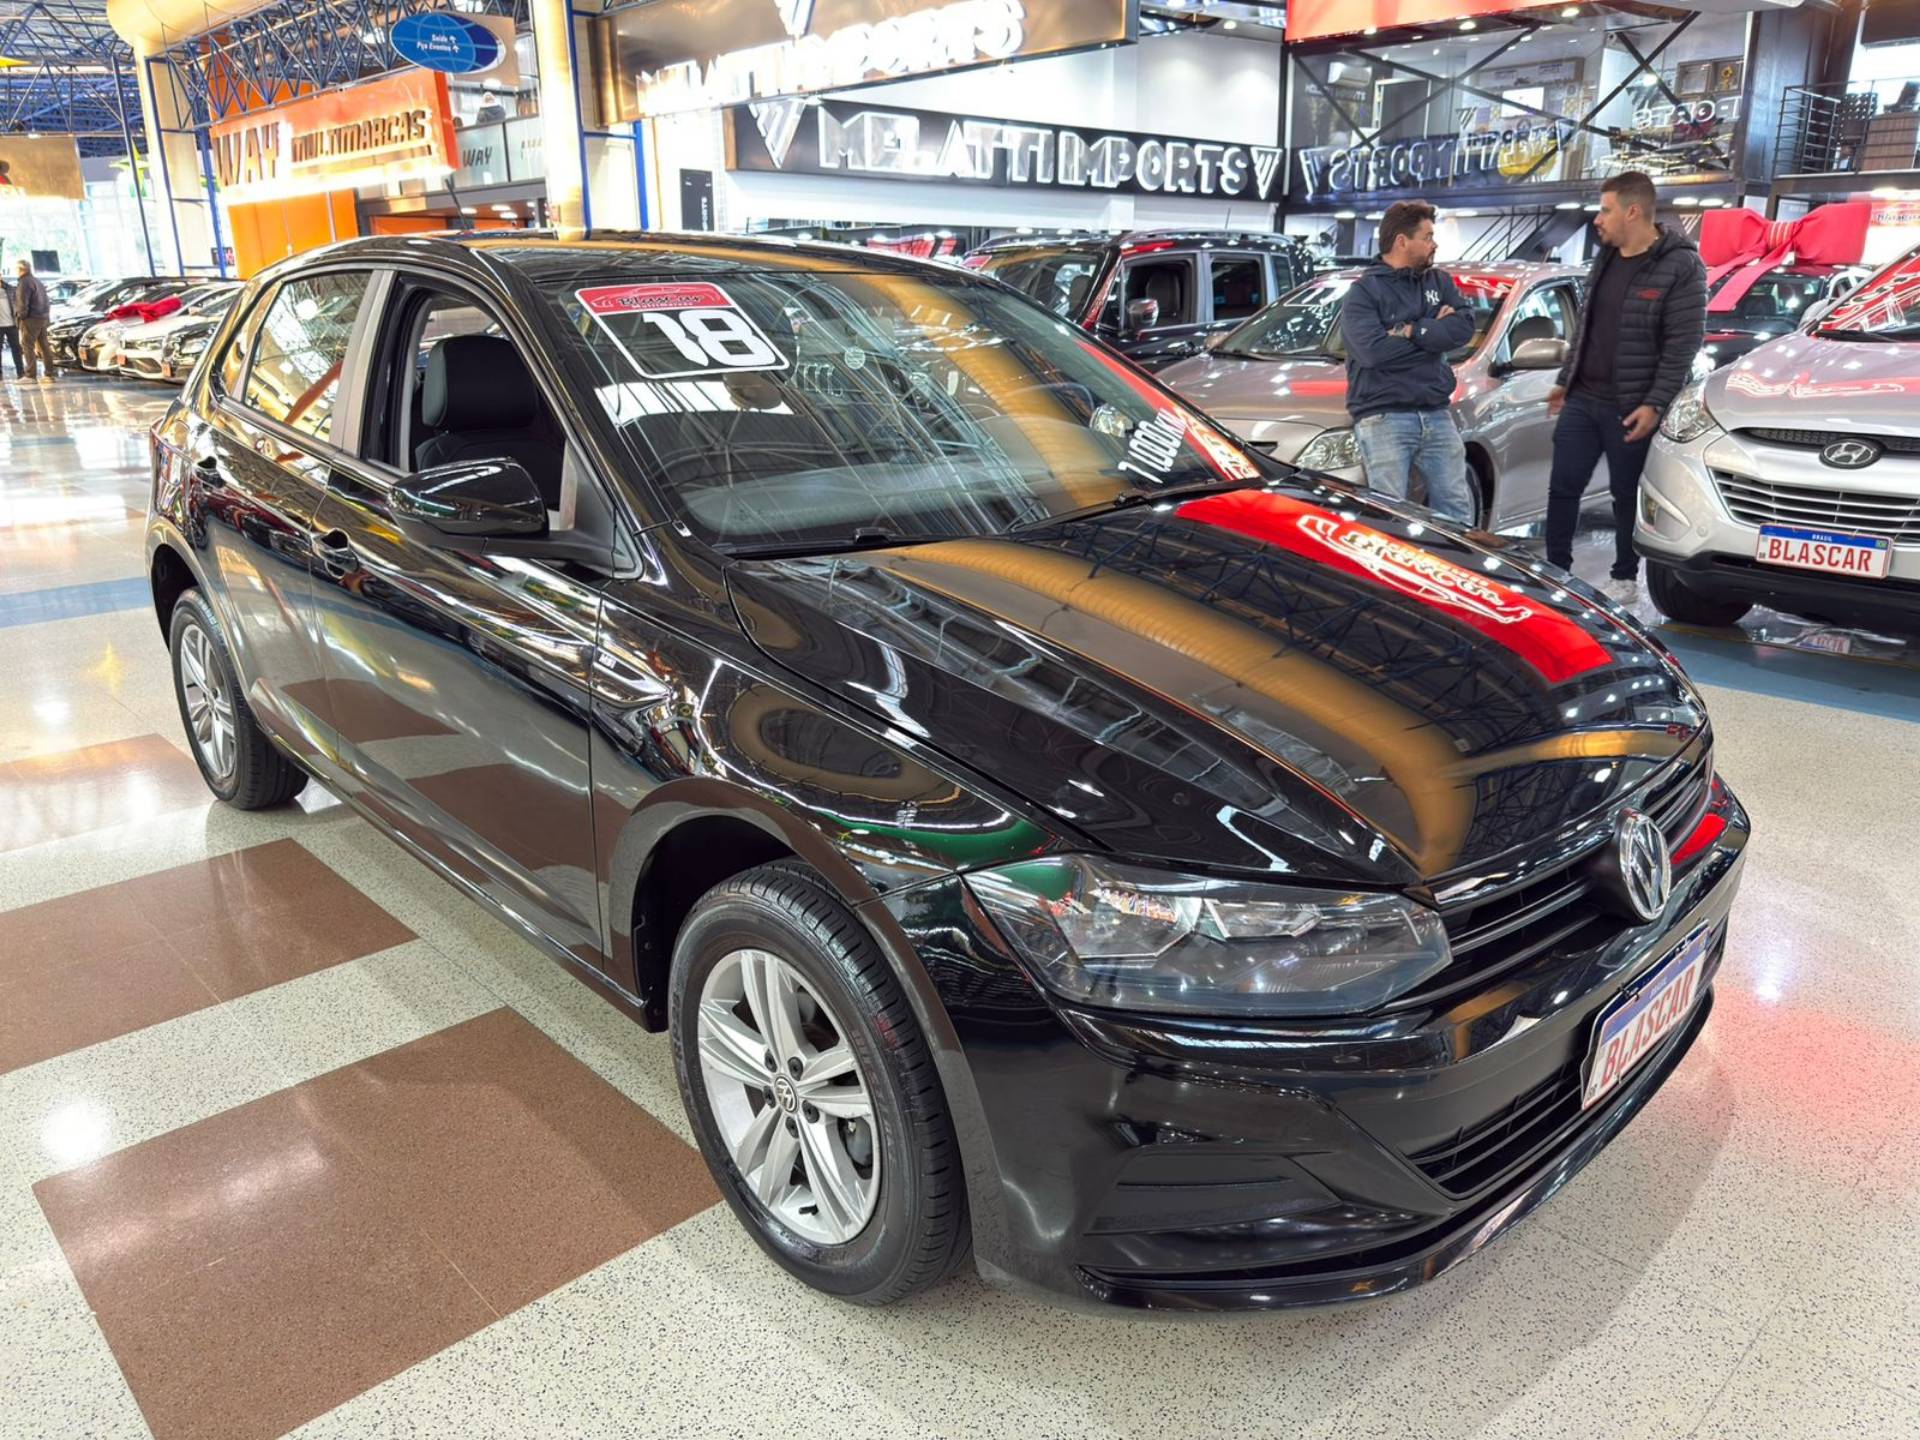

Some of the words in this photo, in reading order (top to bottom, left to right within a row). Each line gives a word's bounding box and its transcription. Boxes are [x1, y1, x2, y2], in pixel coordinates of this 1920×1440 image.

[210, 120, 281, 188] WAY
[290, 109, 428, 164] MULTIMARCAS
[462, 146, 493, 168] WAY
[642, 309, 776, 367] 18
[1768, 538, 1872, 572] BLASCAR
[1600, 964, 1696, 1088] BLASCAR
